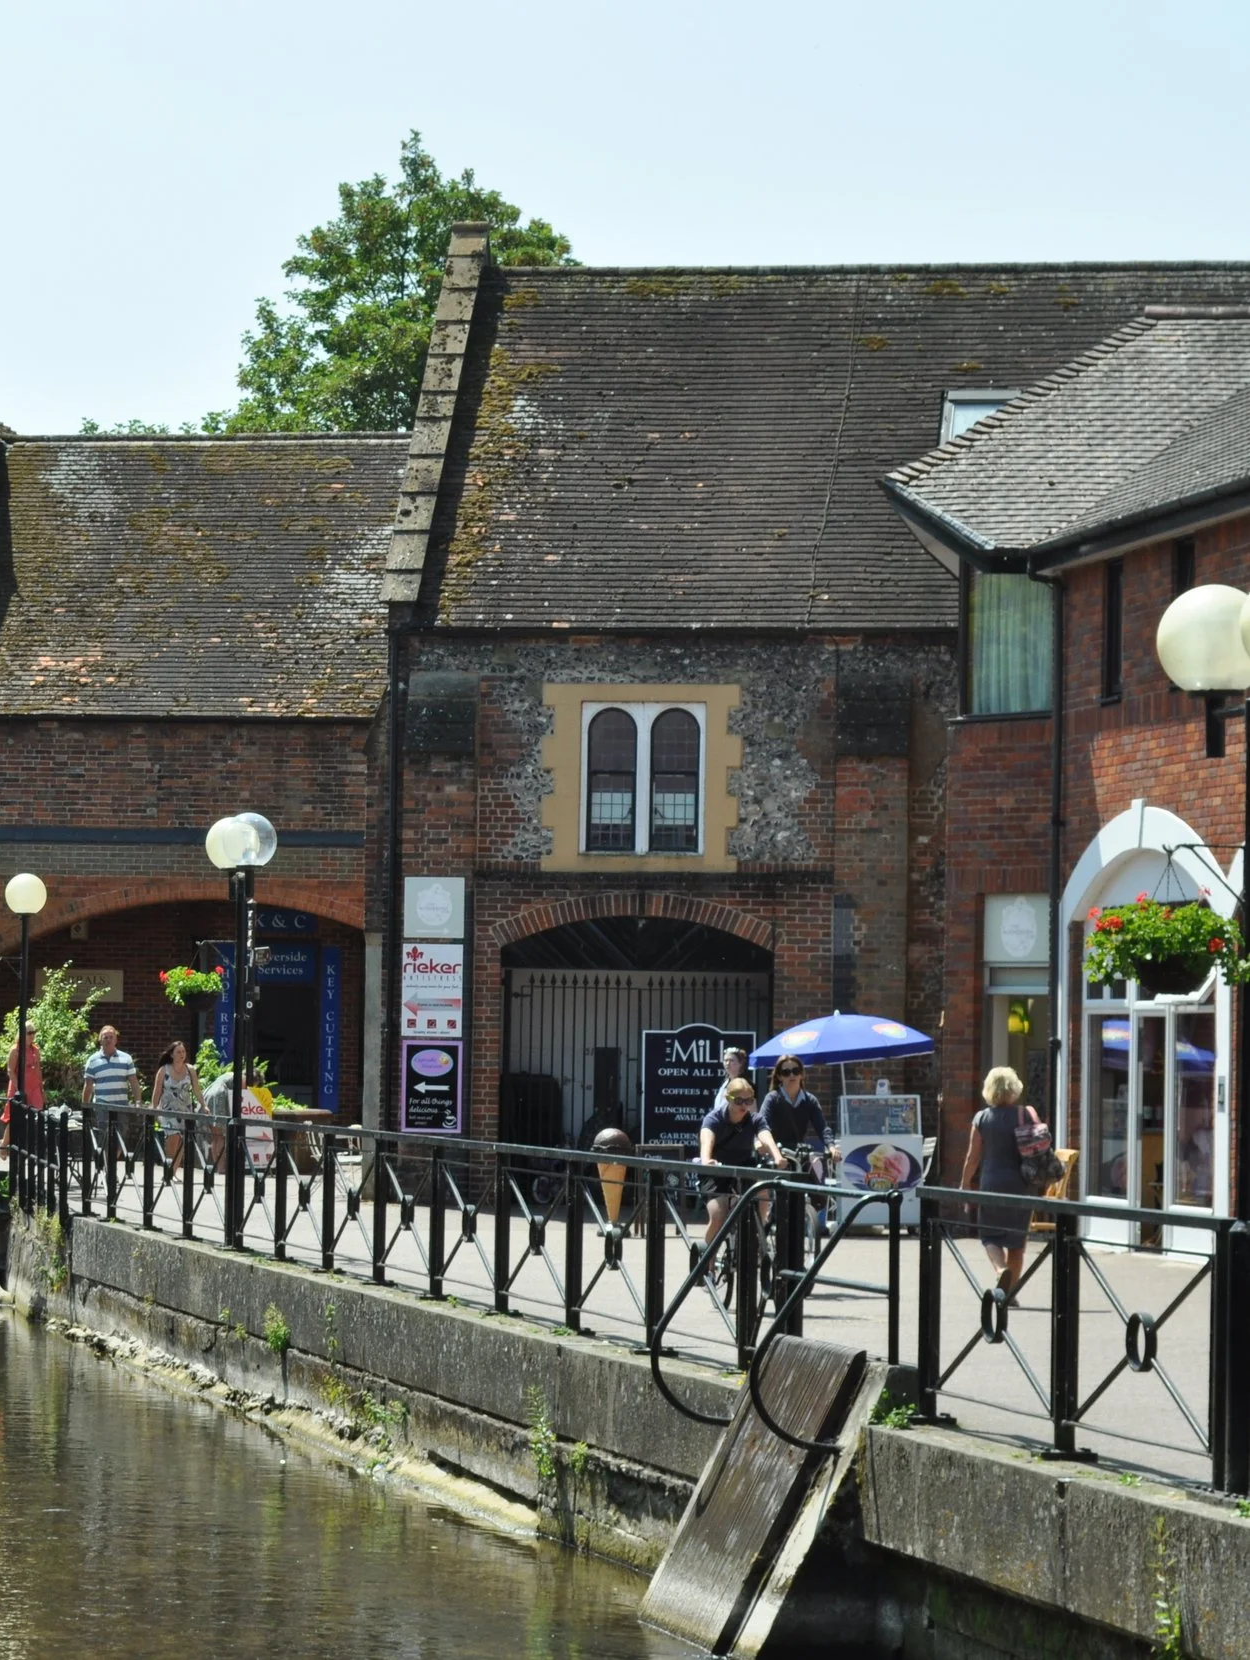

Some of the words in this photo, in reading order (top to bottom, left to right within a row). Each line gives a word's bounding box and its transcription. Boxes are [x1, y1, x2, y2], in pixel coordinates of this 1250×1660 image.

[271, 912, 286, 929] &
[293, 914, 307, 929] C
[268, 951, 308, 963] verside
[257, 964, 304, 976] Services
[403, 958, 462, 974] rieker
[221, 955, 231, 1003] SHOE
[326, 964, 336, 1000] KEY
[323, 1011, 336, 1094] CUTTING
[658, 1068, 689, 1077] OPEN
[692, 1068, 715, 1077] ALL
[662, 1088, 700, 1096] COFFEES
[409, 1097, 420, 1105] For
[420, 1097, 431, 1105] all
[431, 1097, 453, 1108] things
